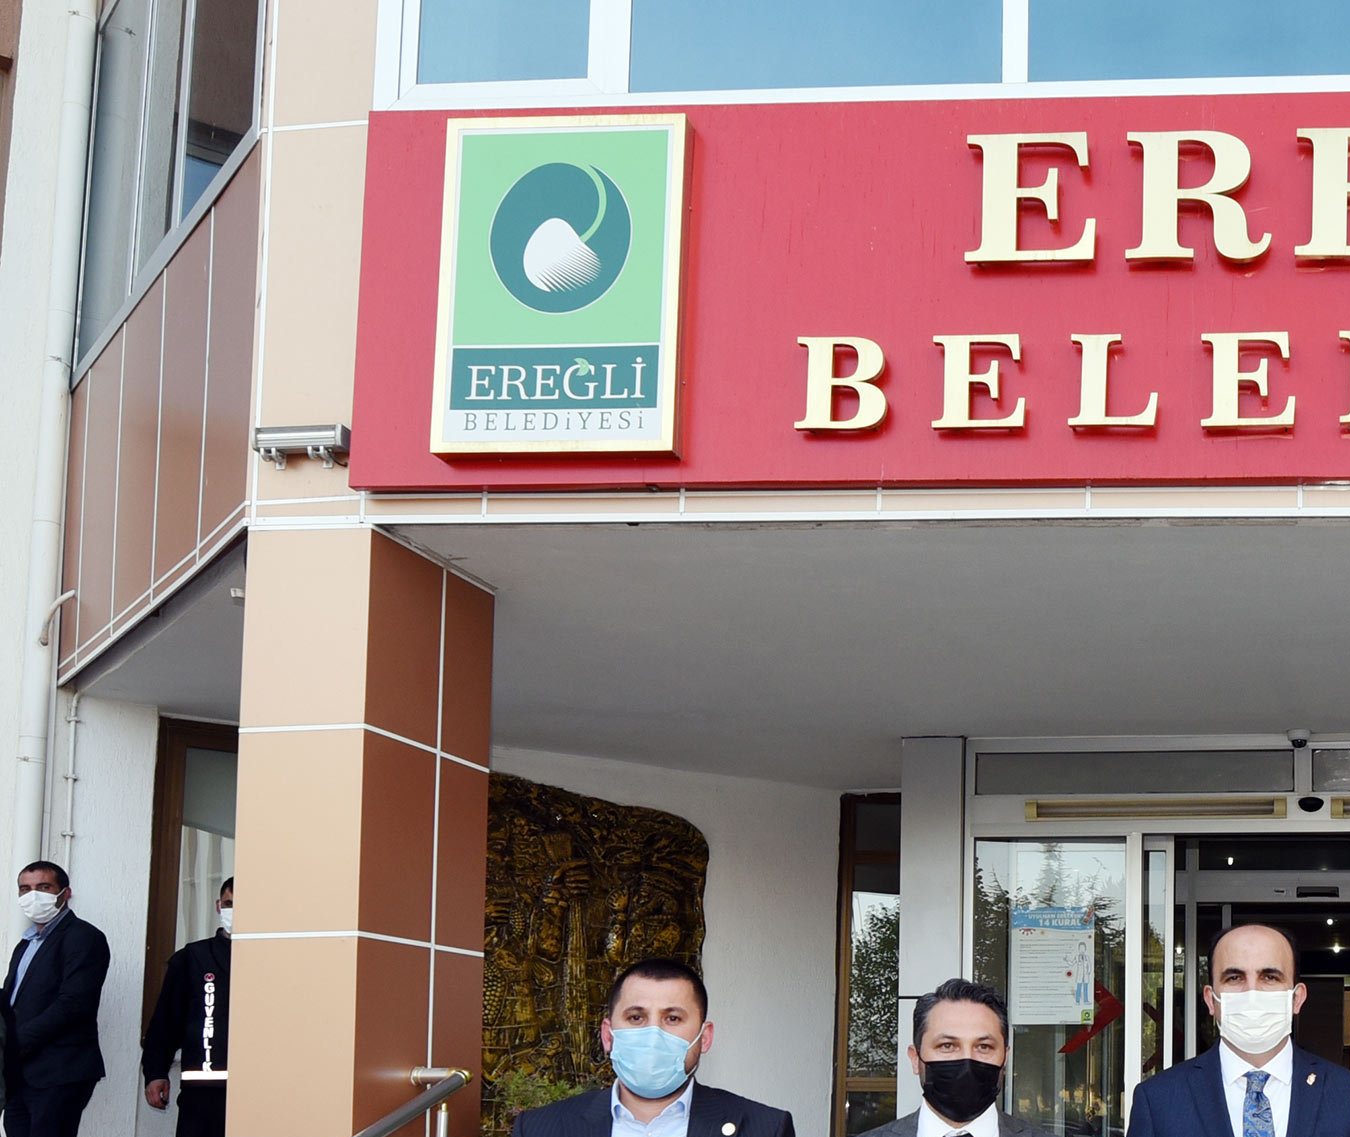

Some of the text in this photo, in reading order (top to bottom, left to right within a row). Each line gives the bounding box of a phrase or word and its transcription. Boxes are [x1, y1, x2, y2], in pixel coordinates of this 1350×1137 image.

[464, 356, 647, 401] EREĞLİ
[1039, 918, 1082, 927] 14 KURAL
